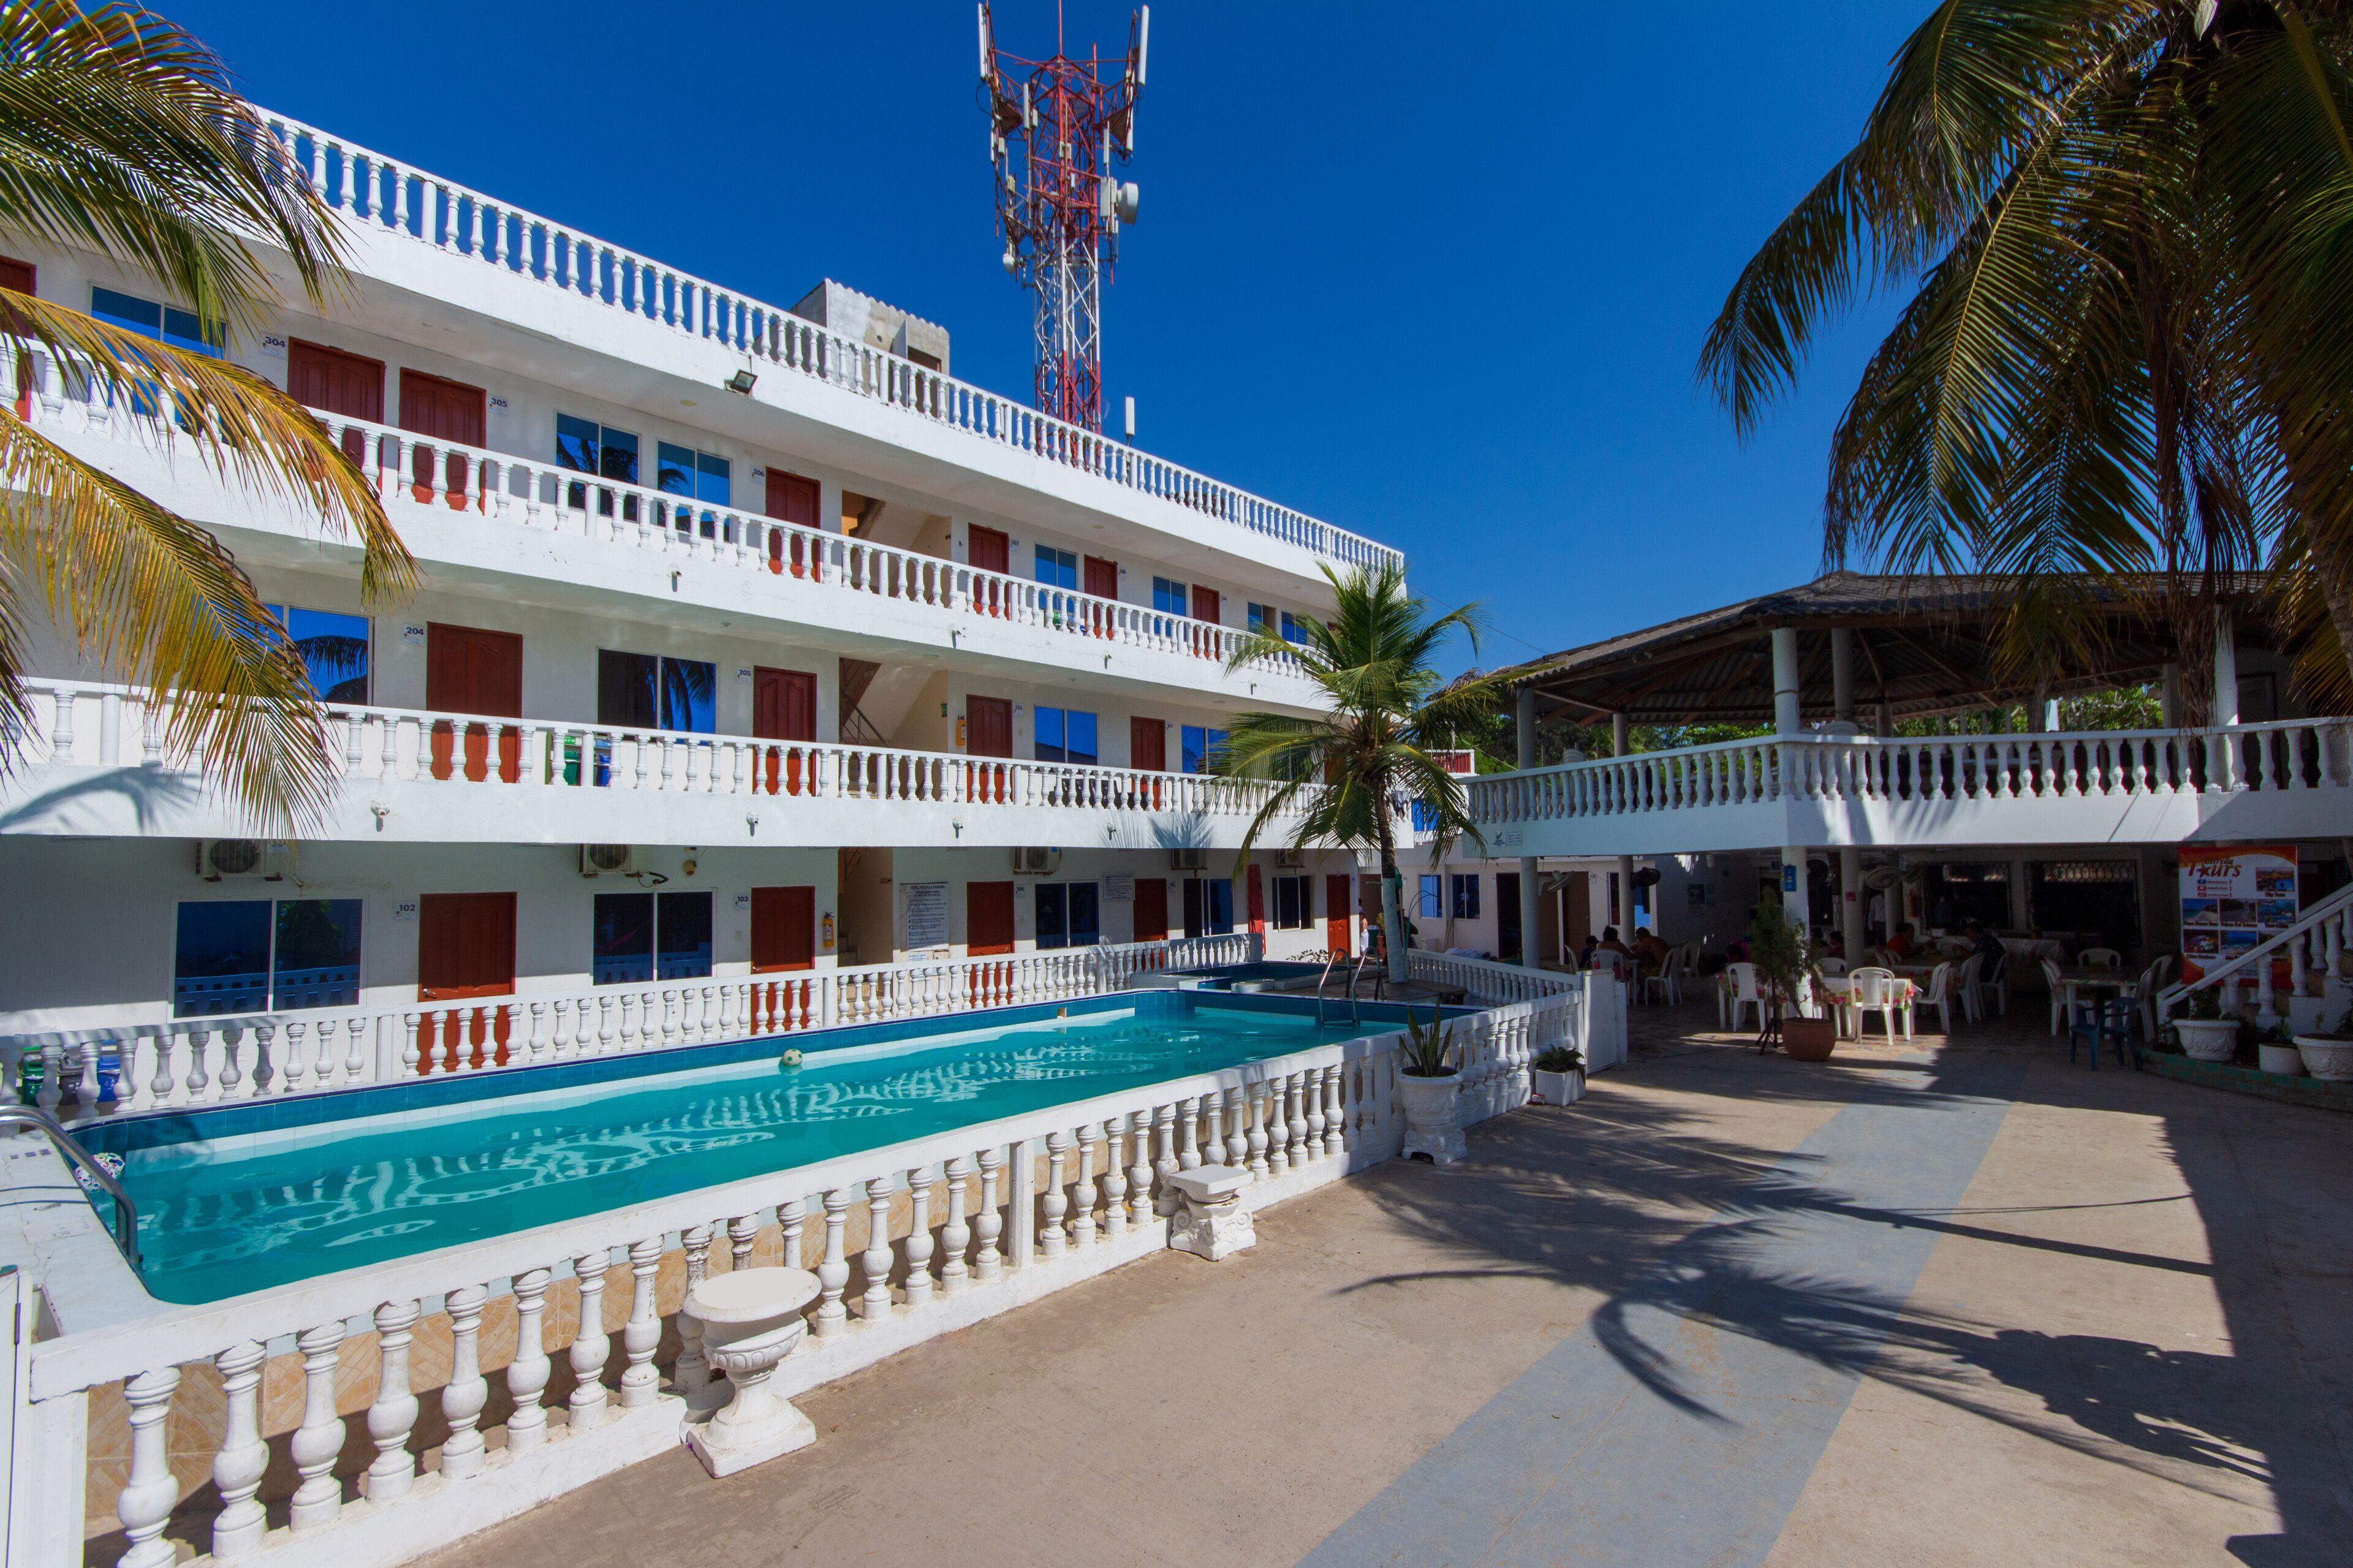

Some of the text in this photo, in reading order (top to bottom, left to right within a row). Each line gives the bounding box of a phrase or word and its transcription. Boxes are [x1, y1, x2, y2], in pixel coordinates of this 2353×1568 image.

[264, 336, 286, 348] 304
[491, 398, 507, 408] 305
[752, 468, 765, 477] 306
[406, 627, 424, 635] 204
